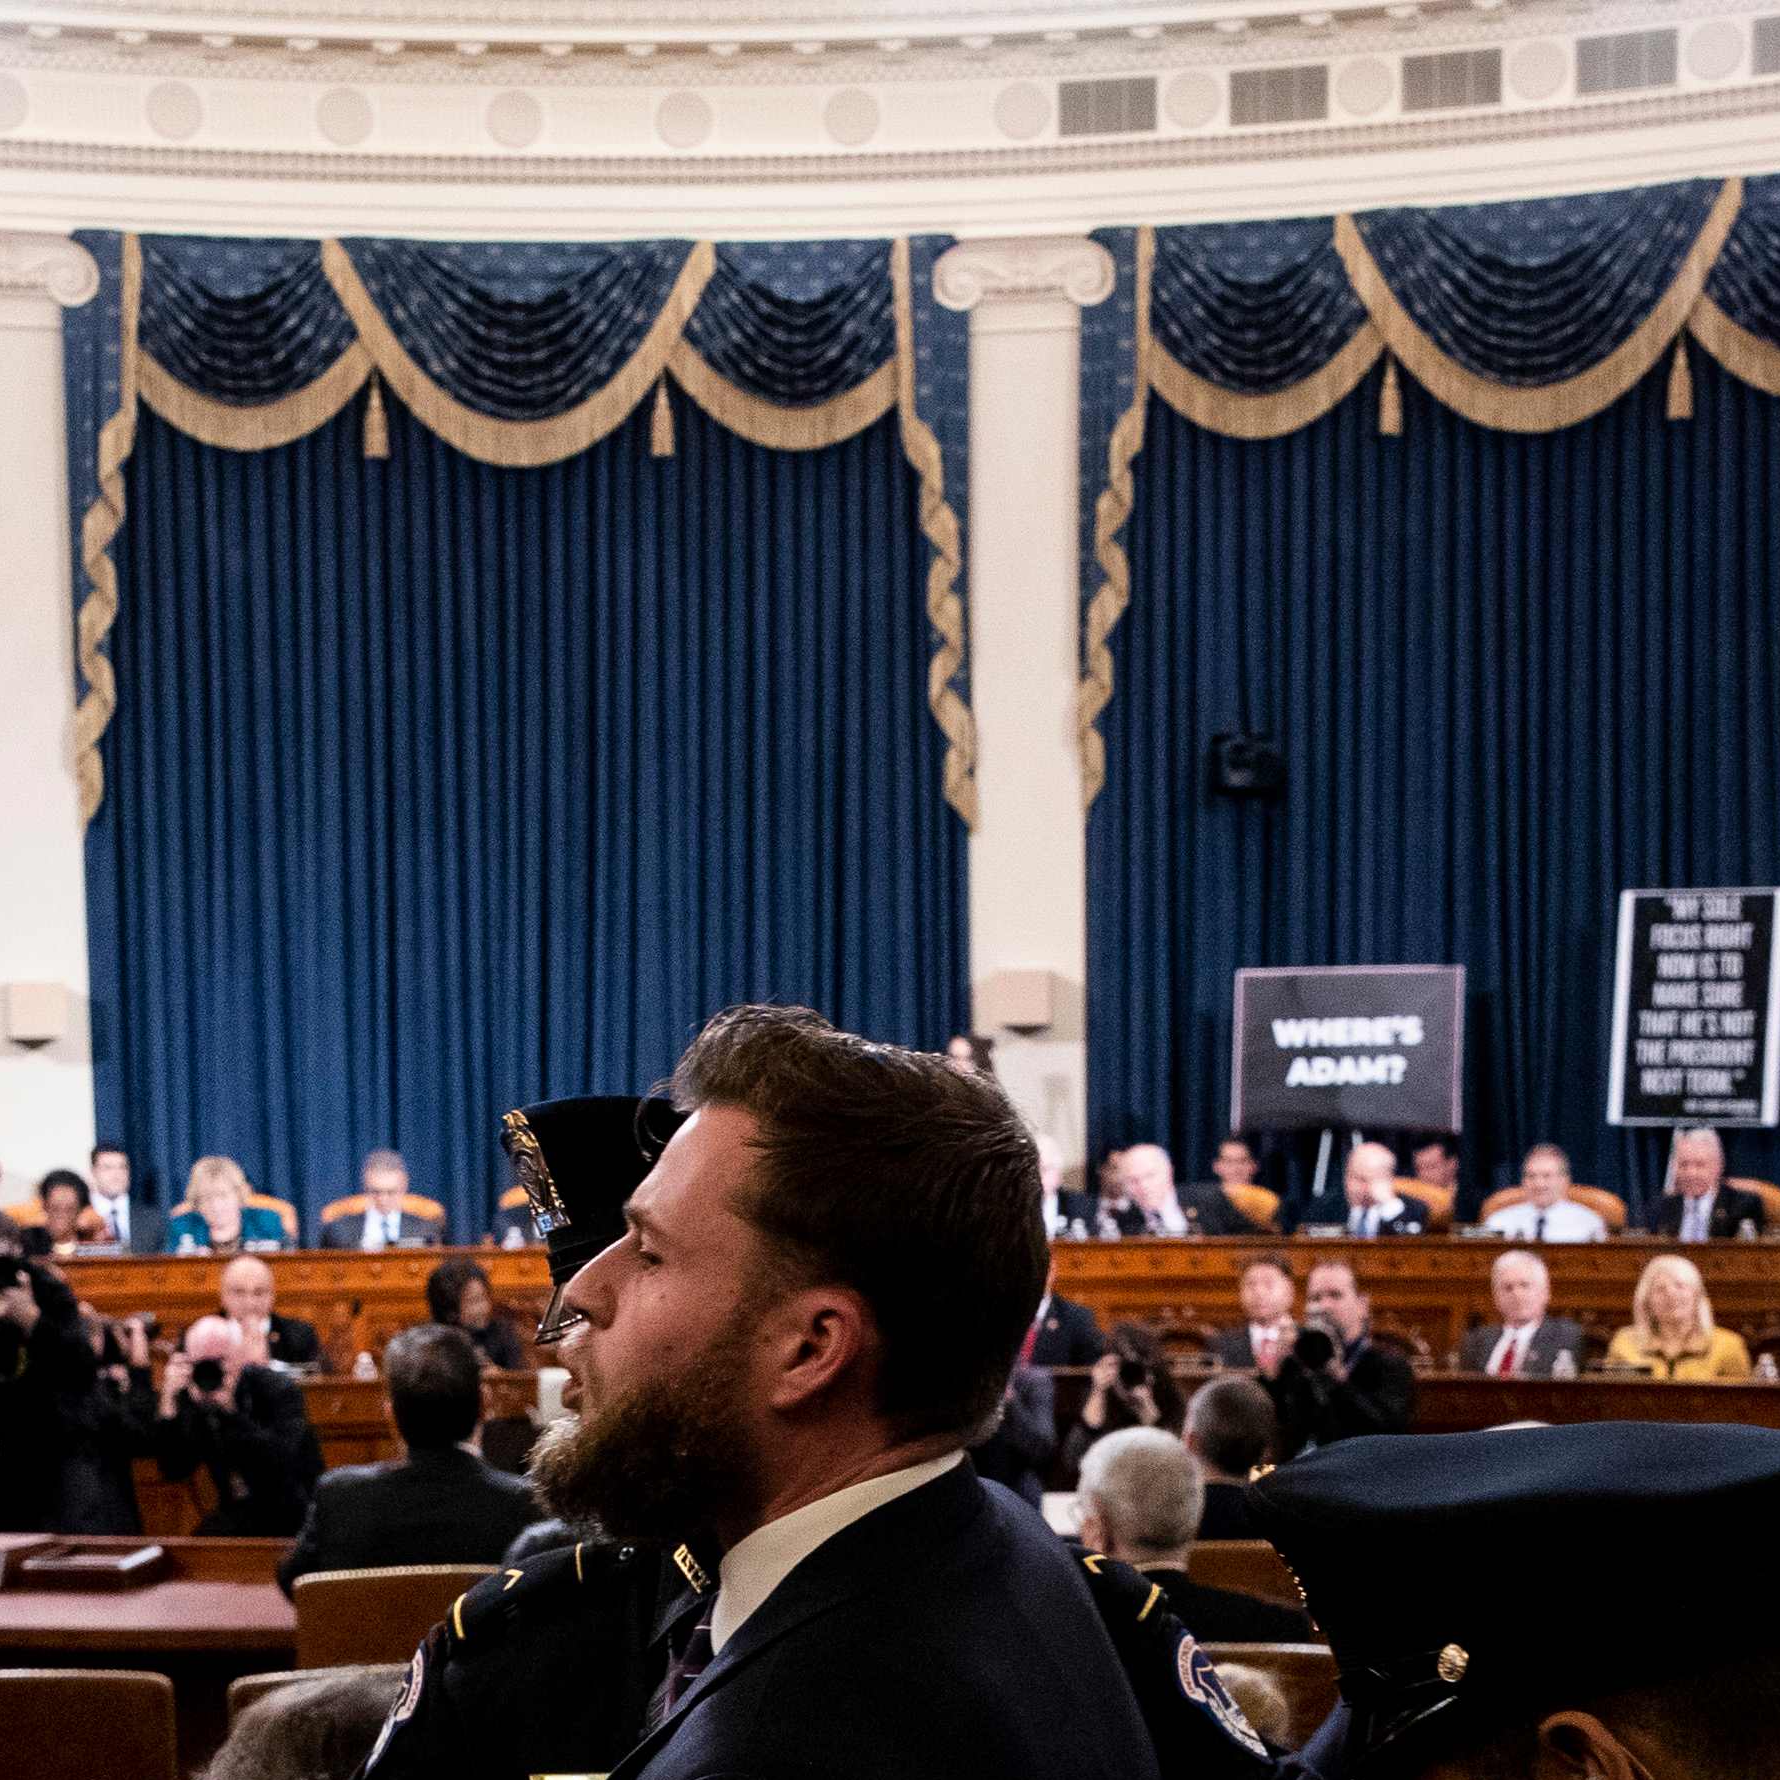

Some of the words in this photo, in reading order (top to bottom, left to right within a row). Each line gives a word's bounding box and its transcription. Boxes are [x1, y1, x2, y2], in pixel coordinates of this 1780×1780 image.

[1272, 1016, 1423, 1048] WHERE'S
[1635, 1038, 1666, 1066] THE
[1667, 1038, 1756, 1066] PRESIDENT
[1285, 1054, 1408, 1087] ADAM?
